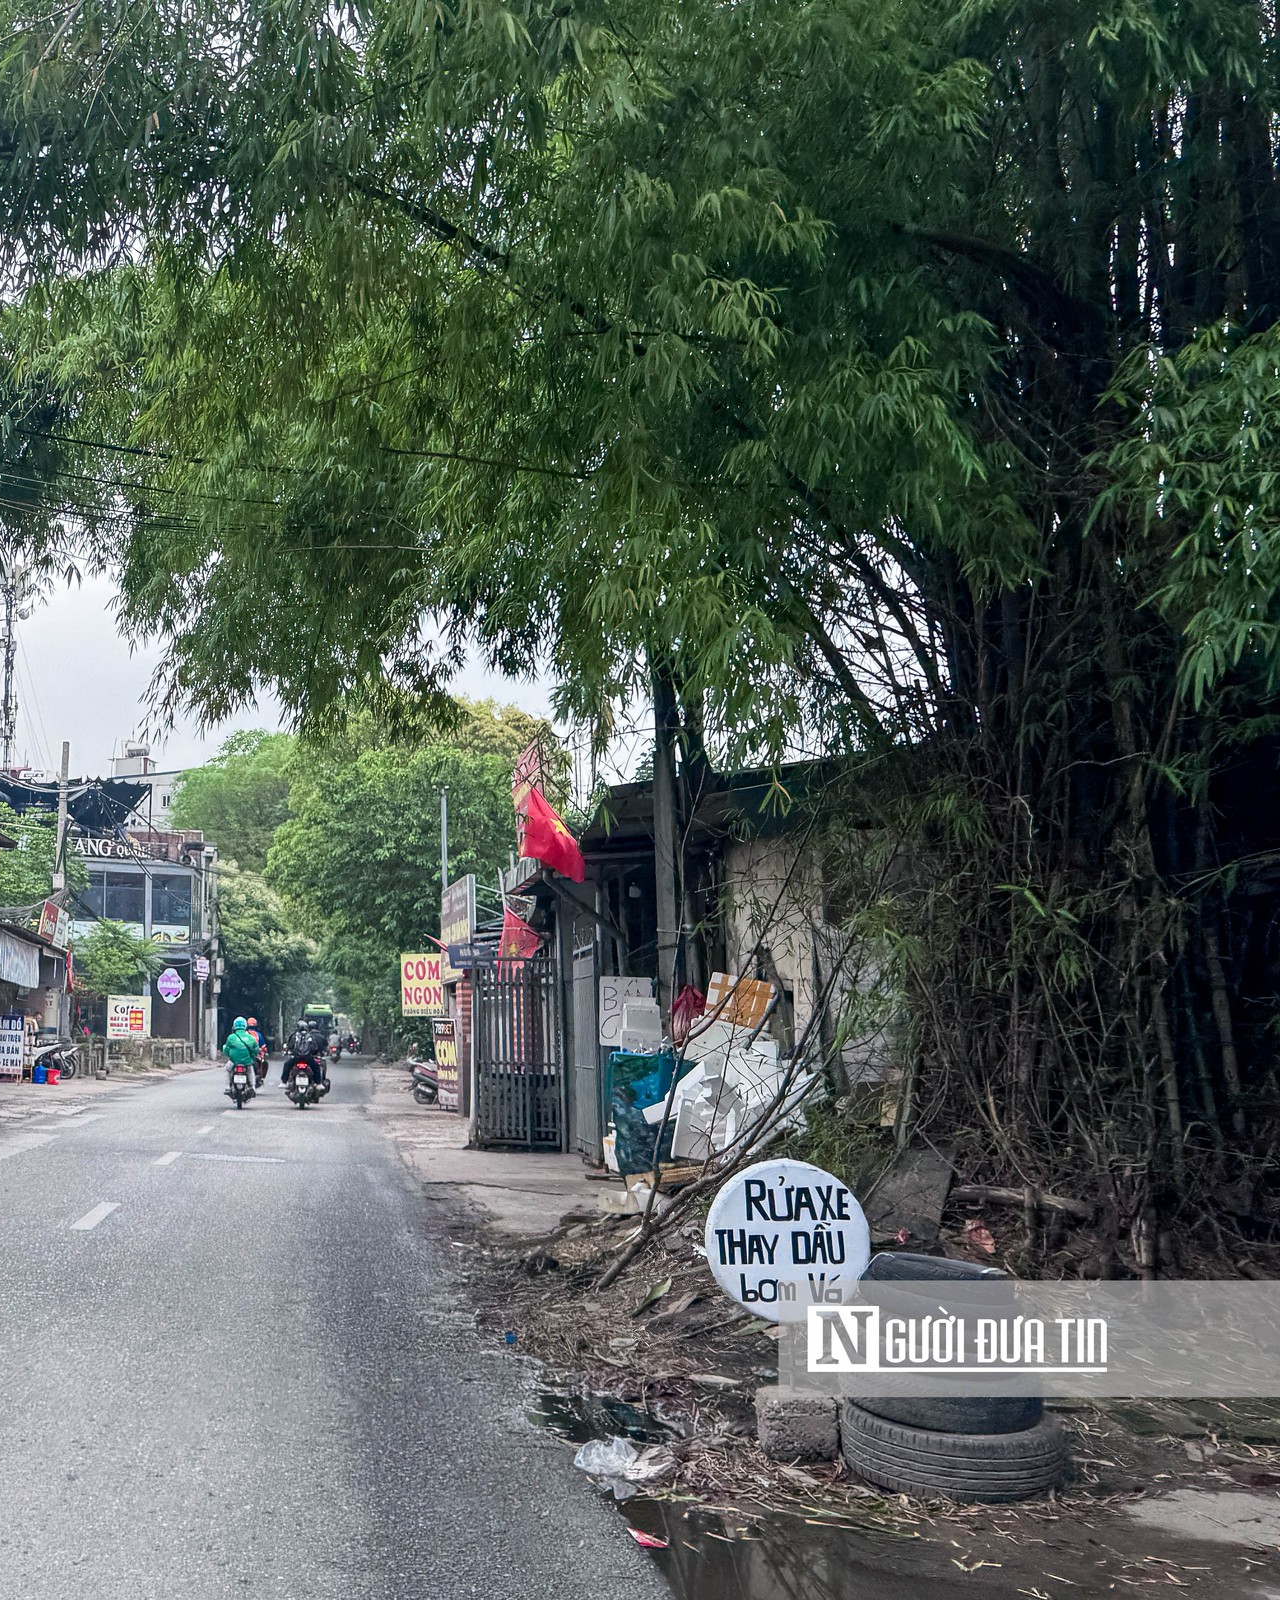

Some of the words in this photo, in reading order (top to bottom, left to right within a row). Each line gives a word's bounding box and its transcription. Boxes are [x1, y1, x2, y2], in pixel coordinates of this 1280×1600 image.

[403, 957, 440, 981] CƠM
[403, 986, 443, 1006] NGON
[435, 1040, 457, 1067] CƠM
[714, 1228, 779, 1266] THAY
[791, 1219, 846, 1266] DẦU
[740, 1272, 796, 1303] bơm
[809, 1273, 843, 1304] Vá
